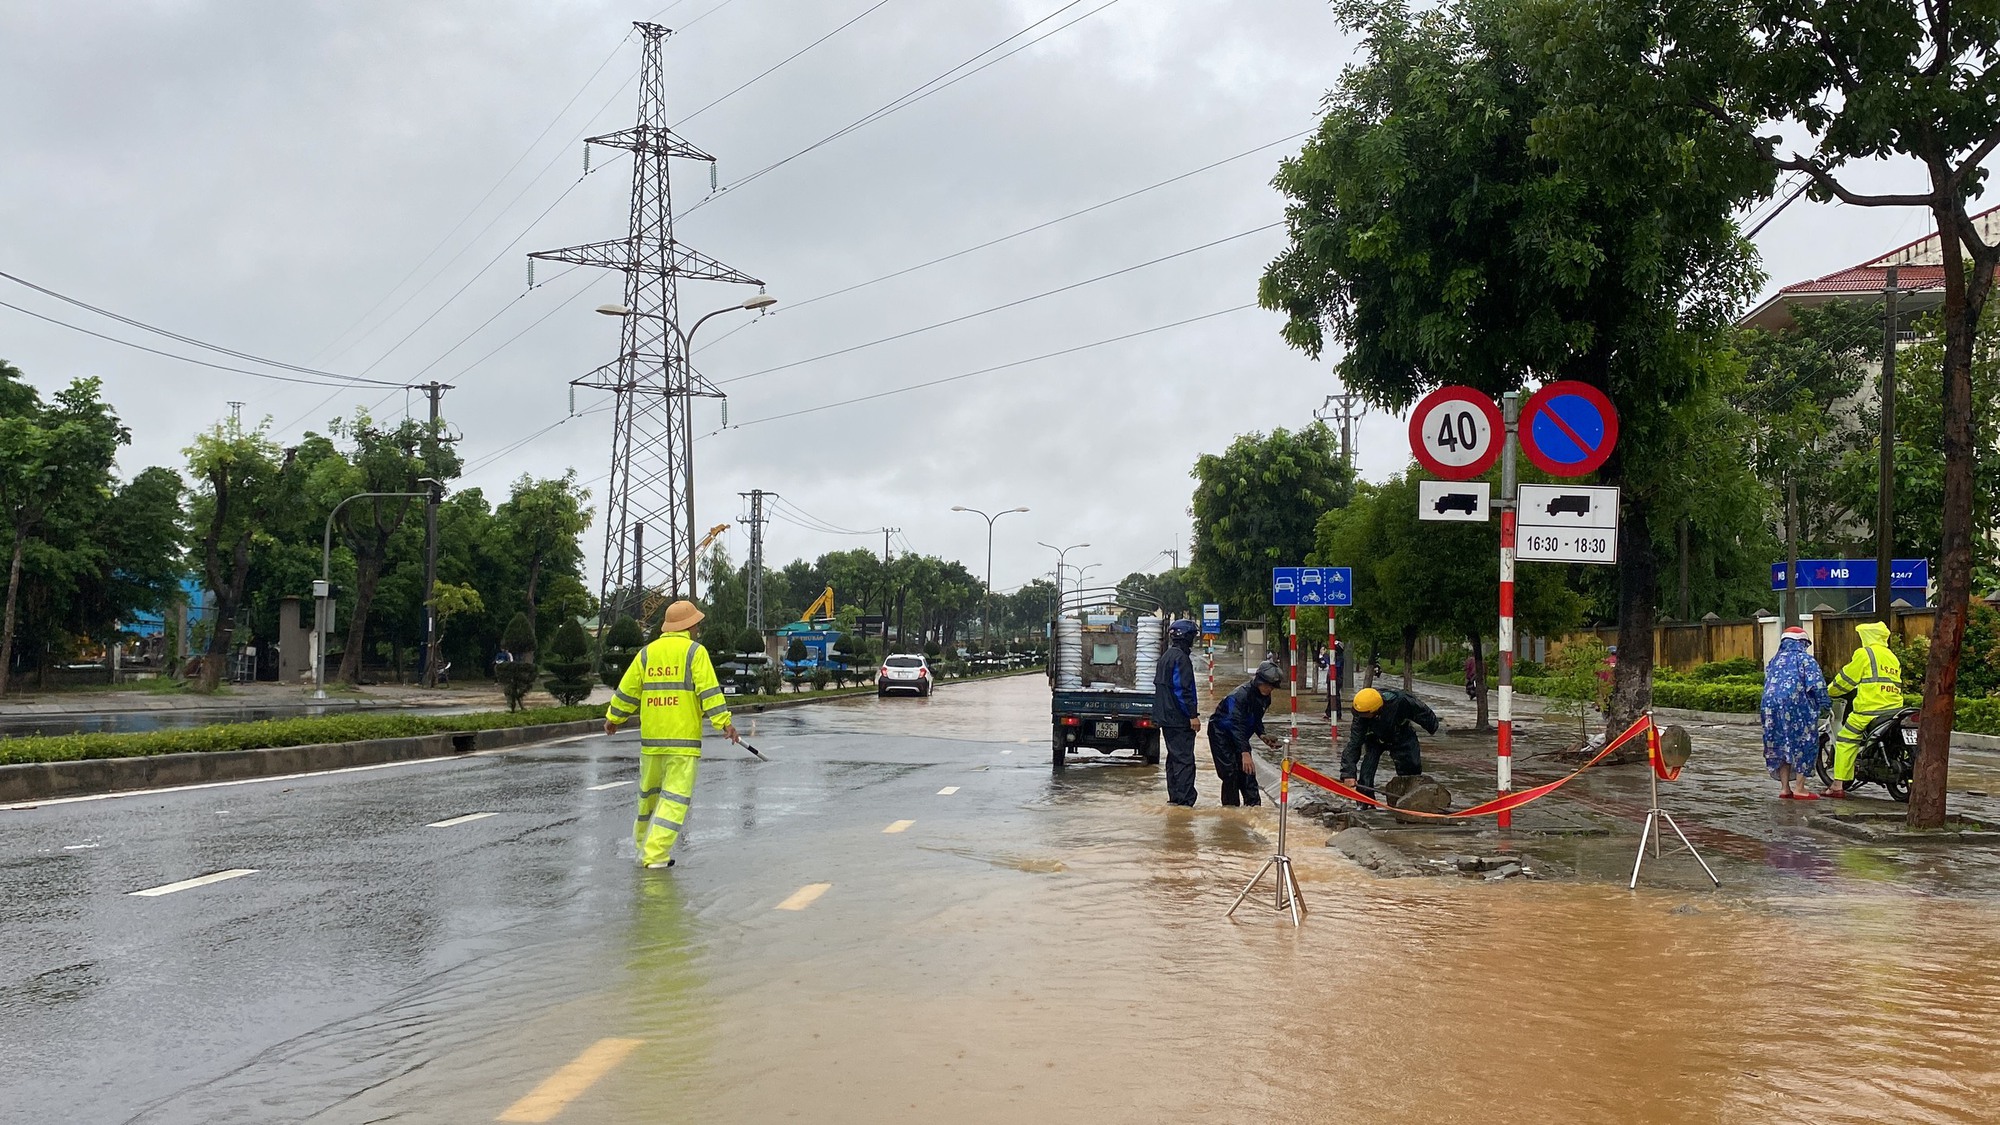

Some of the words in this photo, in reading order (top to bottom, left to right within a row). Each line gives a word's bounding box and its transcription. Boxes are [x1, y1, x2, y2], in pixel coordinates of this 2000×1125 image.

[1437, 411, 1477, 452] 40
[1527, 535, 1559, 552] 16:30
[1574, 537, 1606, 554] 18:30
[1830, 568, 1850, 579] MB
[648, 666, 679, 677] C.S.G.T
[647, 696, 679, 708] POLICE
